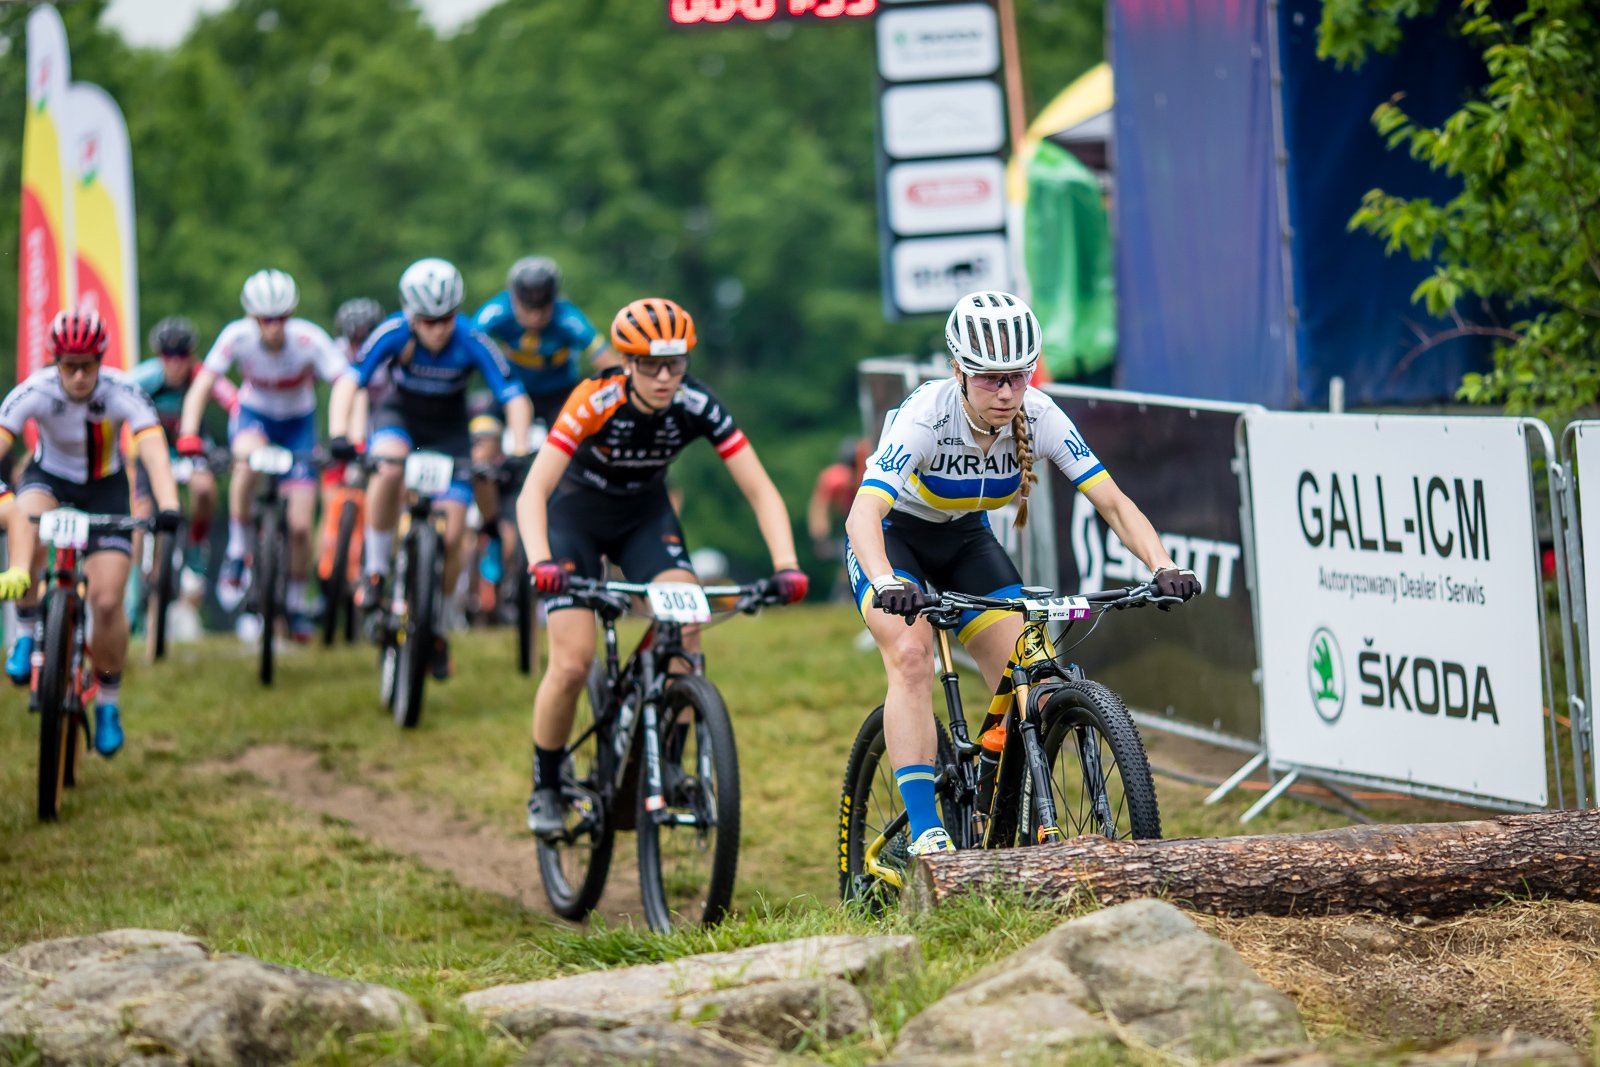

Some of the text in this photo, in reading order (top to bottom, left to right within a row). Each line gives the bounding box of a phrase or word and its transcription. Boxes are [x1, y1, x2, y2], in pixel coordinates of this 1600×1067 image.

[929, 453, 1020, 475] UKRAIN
[1297, 470, 1490, 561] GALL-ICM
[659, 590, 698, 610] 303
[1318, 566, 1486, 605] Autoryzowany Dealer i Serwis
[1073, 609, 1086, 618] JW
[1358, 637, 1500, 725] ŠKODA
[840, 794, 851, 873] MAXXIS
